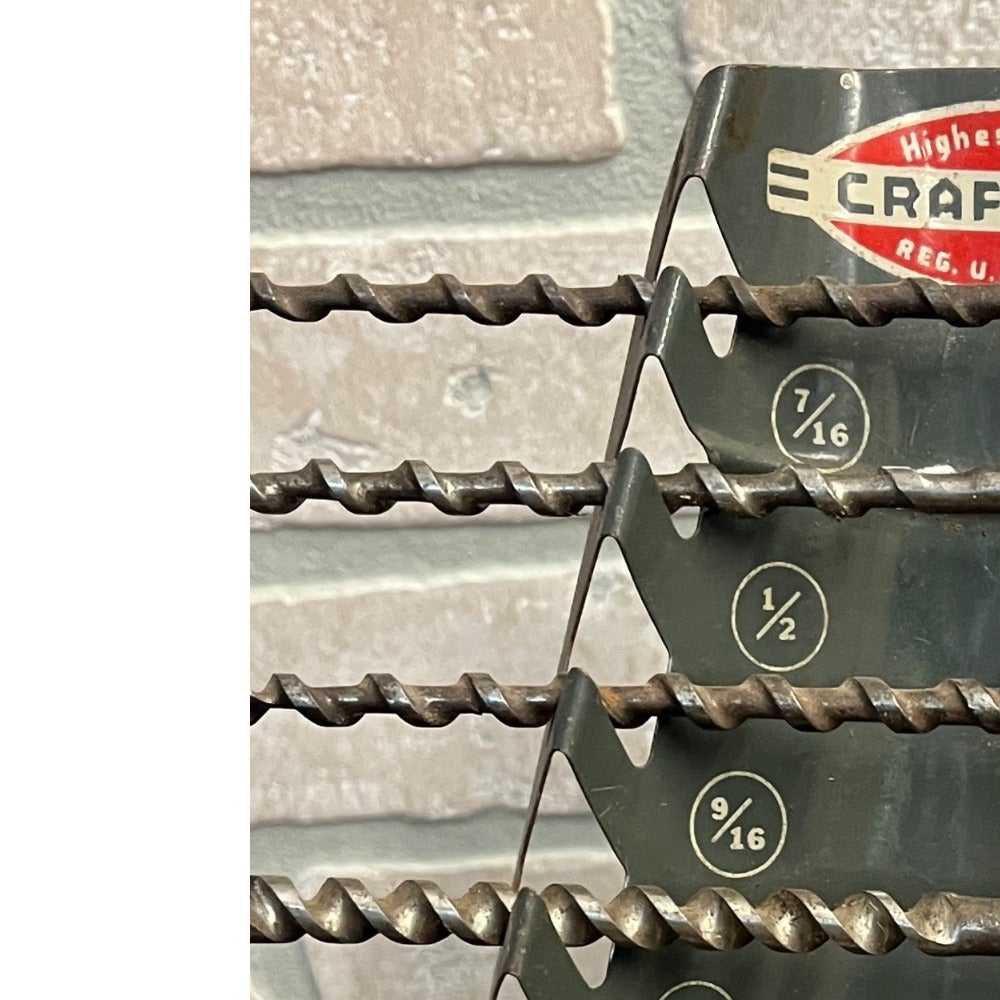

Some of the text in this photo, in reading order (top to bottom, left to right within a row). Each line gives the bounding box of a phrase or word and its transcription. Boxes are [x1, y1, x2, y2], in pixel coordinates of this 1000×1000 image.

[896, 239, 958, 273] REG.
[792, 388, 849, 447] 7/16
[755, 587, 801, 641] 1/2
[710, 796, 766, 851] 9/16
